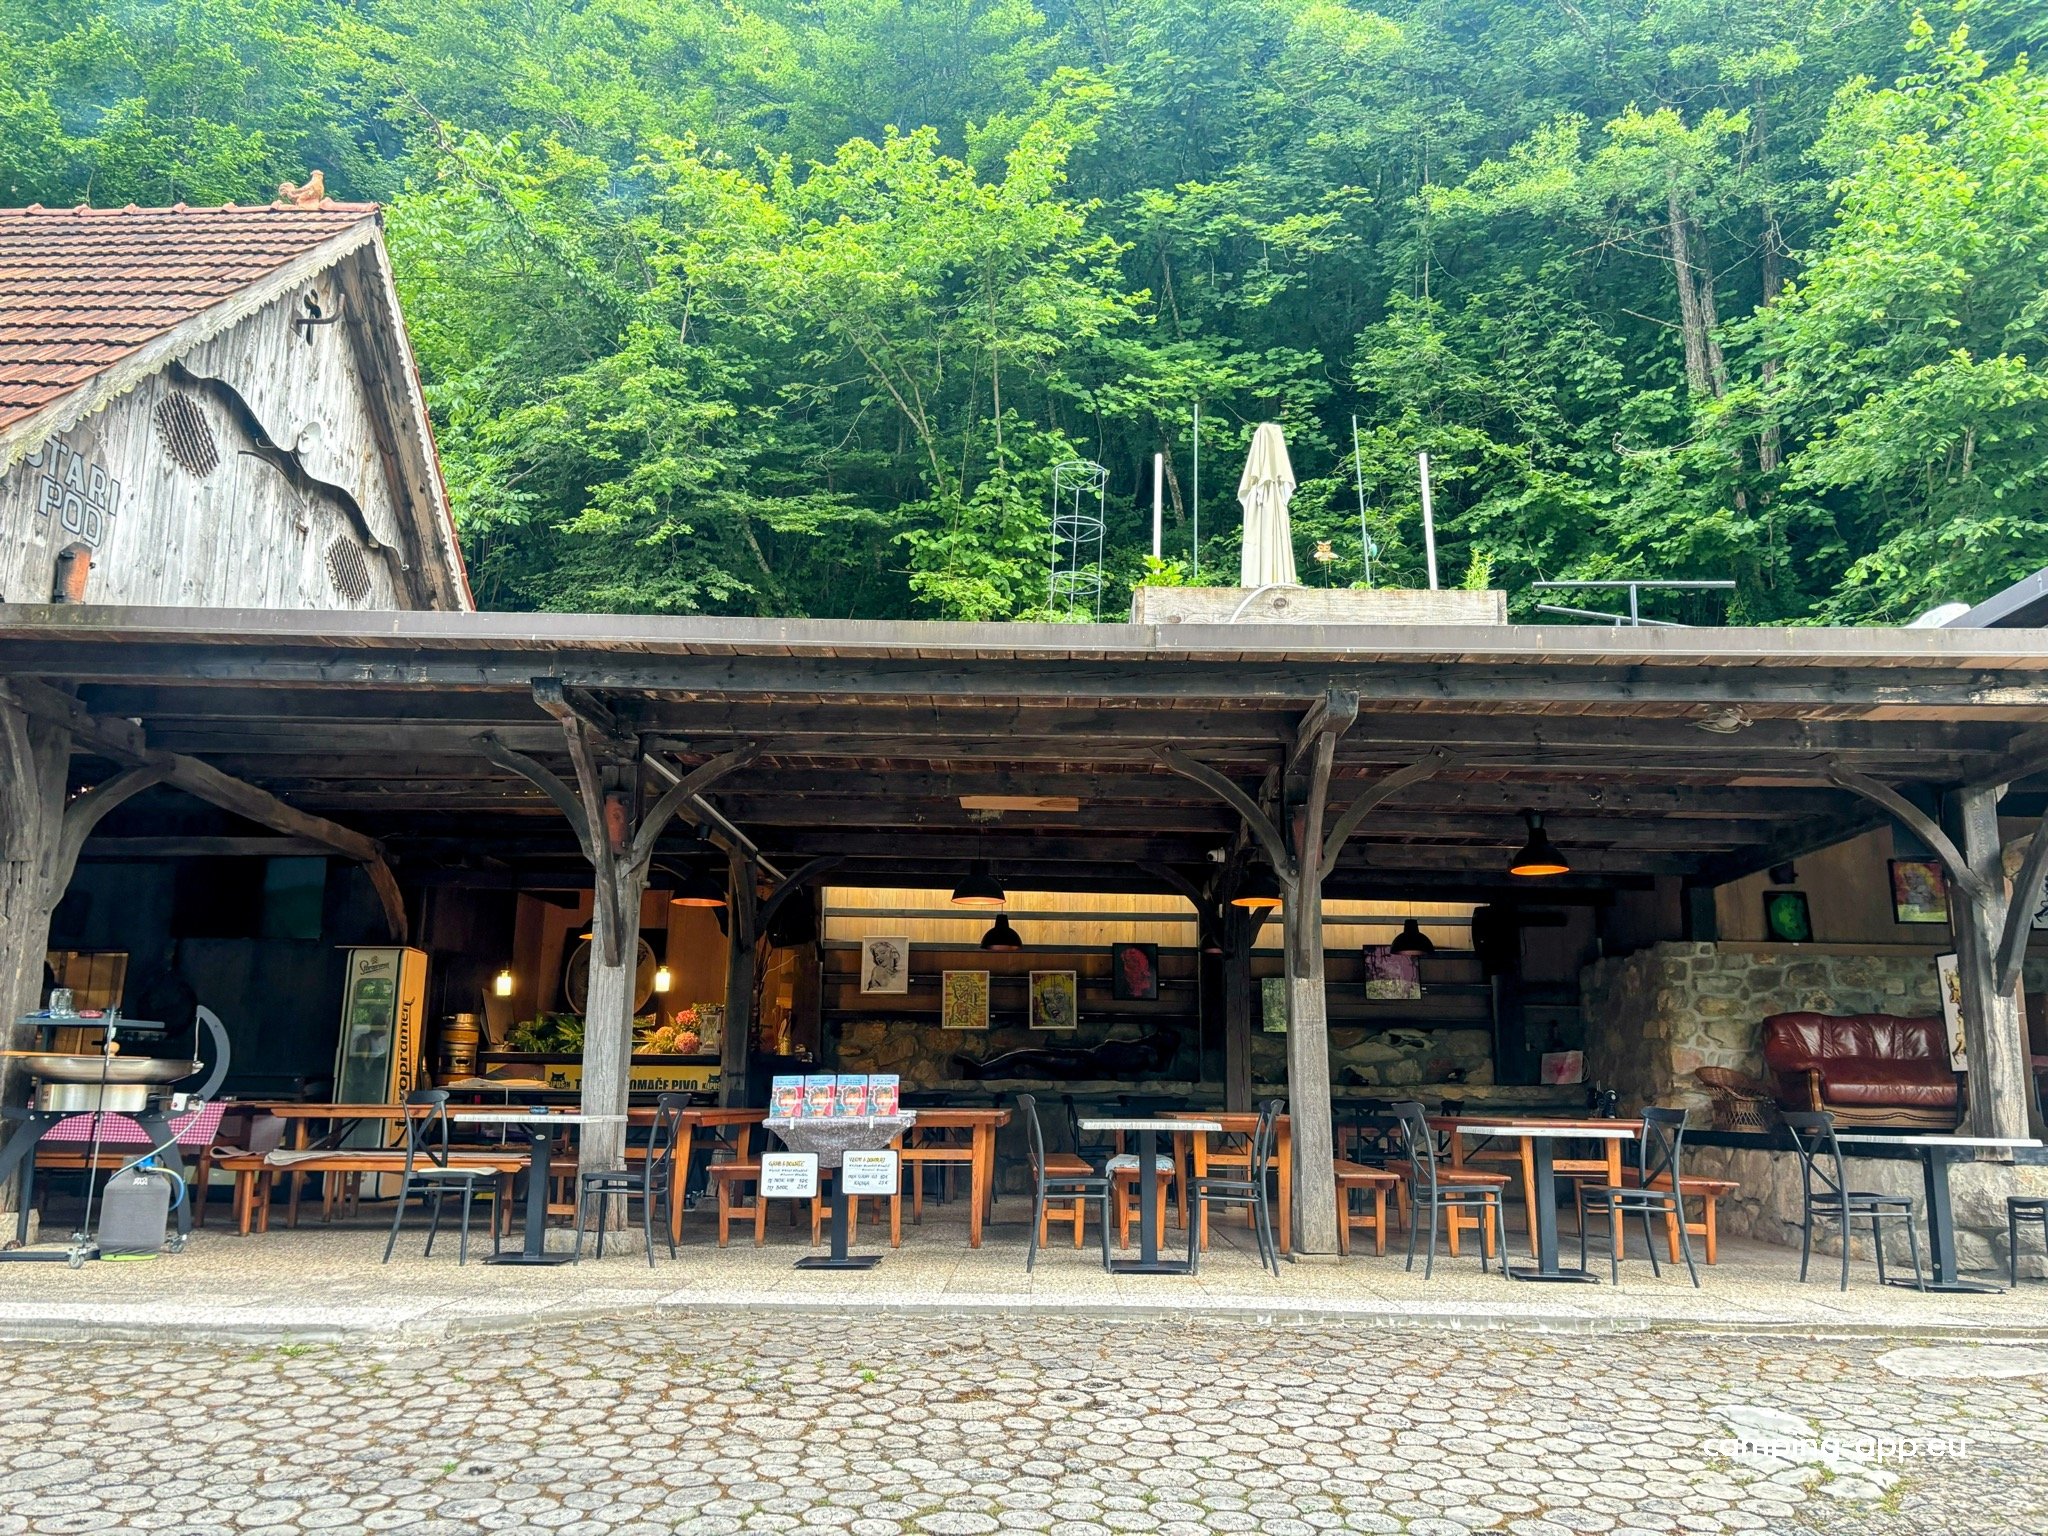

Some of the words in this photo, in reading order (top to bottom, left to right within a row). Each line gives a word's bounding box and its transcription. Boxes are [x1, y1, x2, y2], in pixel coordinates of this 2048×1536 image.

[38, 475, 103, 548] POD
[629, 1077, 669, 1090] OMAČE
[672, 1080, 698, 1090] PIVO
